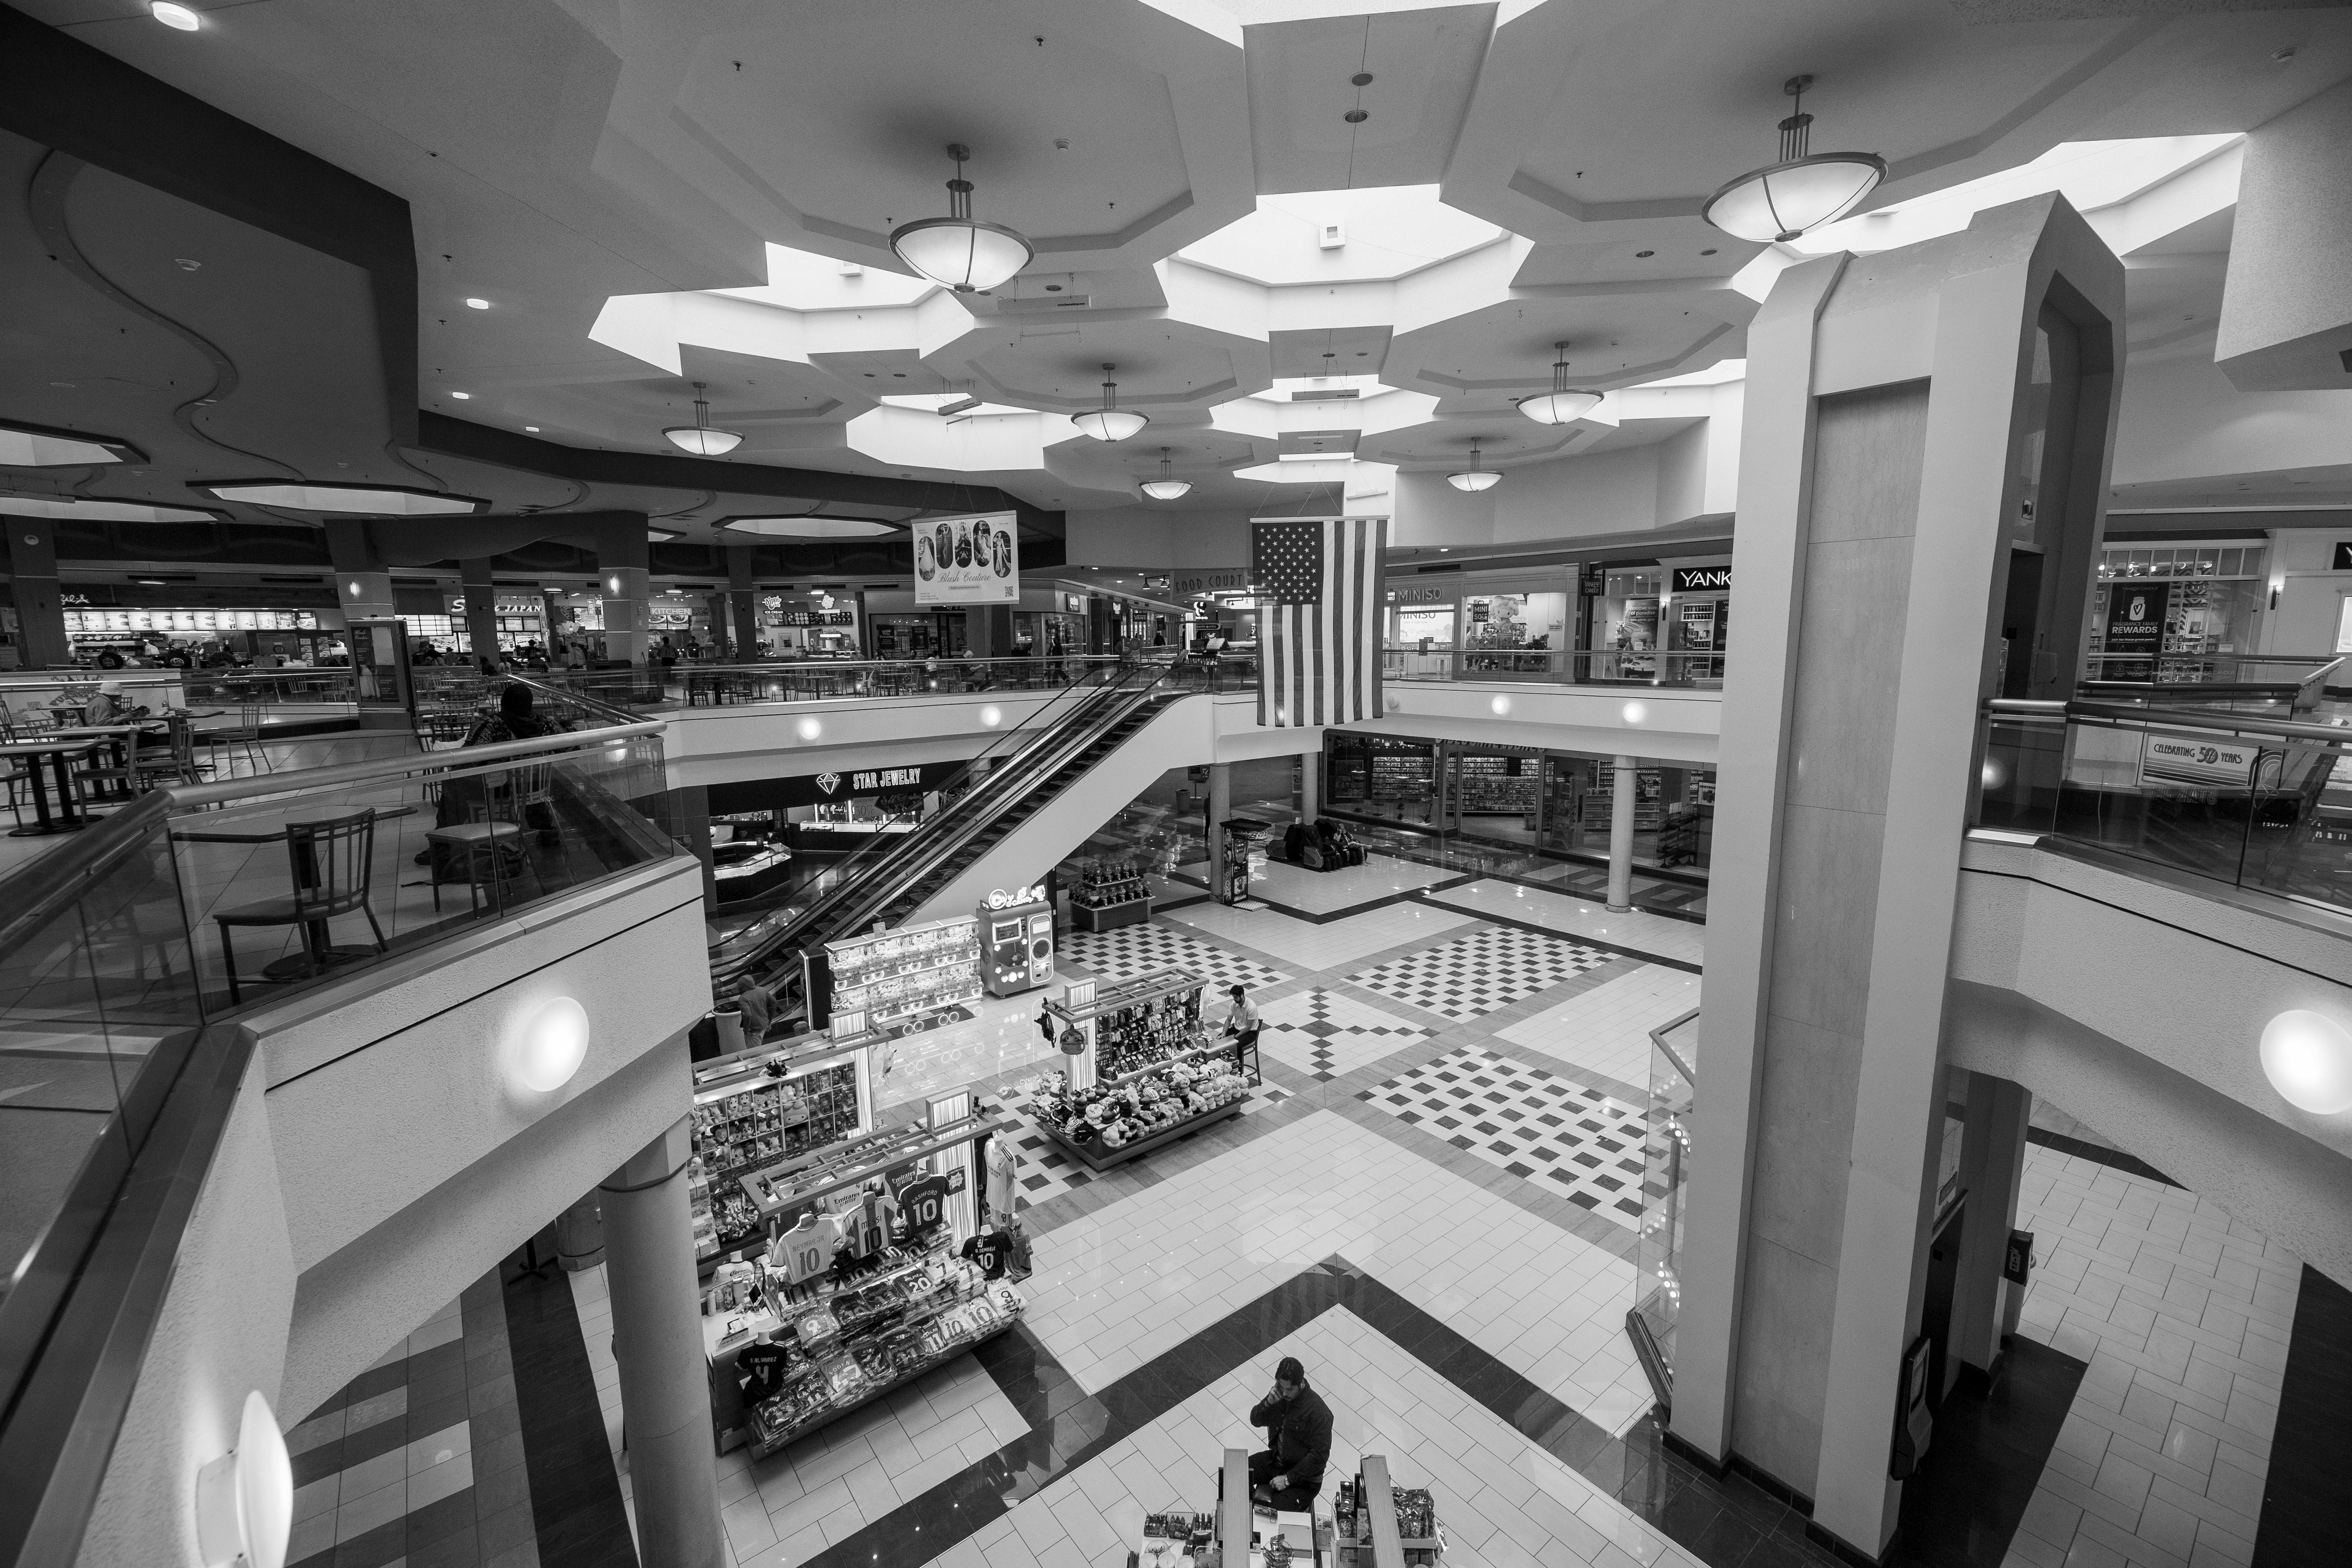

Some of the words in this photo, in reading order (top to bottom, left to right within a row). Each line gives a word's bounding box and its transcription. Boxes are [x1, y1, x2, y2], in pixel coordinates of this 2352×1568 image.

[937, 571, 960, 583] Blush
[963, 571, 992, 582] Couture
[1176, 578, 1202, 593] FOOD
[1209, 575, 1242, 587] COURT
[1399, 587, 1442, 602] MINISO
[2154, 744, 2195, 758] CELEBRATING
[2197, 746, 2218, 764] 50
[2221, 752, 2243, 764] YEARS
[853, 772, 878, 790] STAR
[880, 768, 920, 787] JEWELRY
[855, 804, 875, 817] 50%
[892, 1171, 915, 1184] Emirates
[834, 1192, 860, 1204] Emirates
[911, 1190, 937, 1204] RASHFORD
[913, 1199, 937, 1226] 10
[861, 1215, 882, 1229] MESSI
[792, 1240, 815, 1253] NEYMAR
[864, 1226, 882, 1254] 10
[800, 1247, 820, 1276] 10
[936, 1262, 946, 1276] 7
[978, 1253, 994, 1270] 10
[909, 1277, 932, 1293] 20
[1001, 1290, 1013, 1303] 9
[968, 1307, 993, 1326] 10
[945, 1320, 964, 1337] 10
[756, 1365, 769, 1385] 4
[829, 1361, 850, 1375] FODEN
